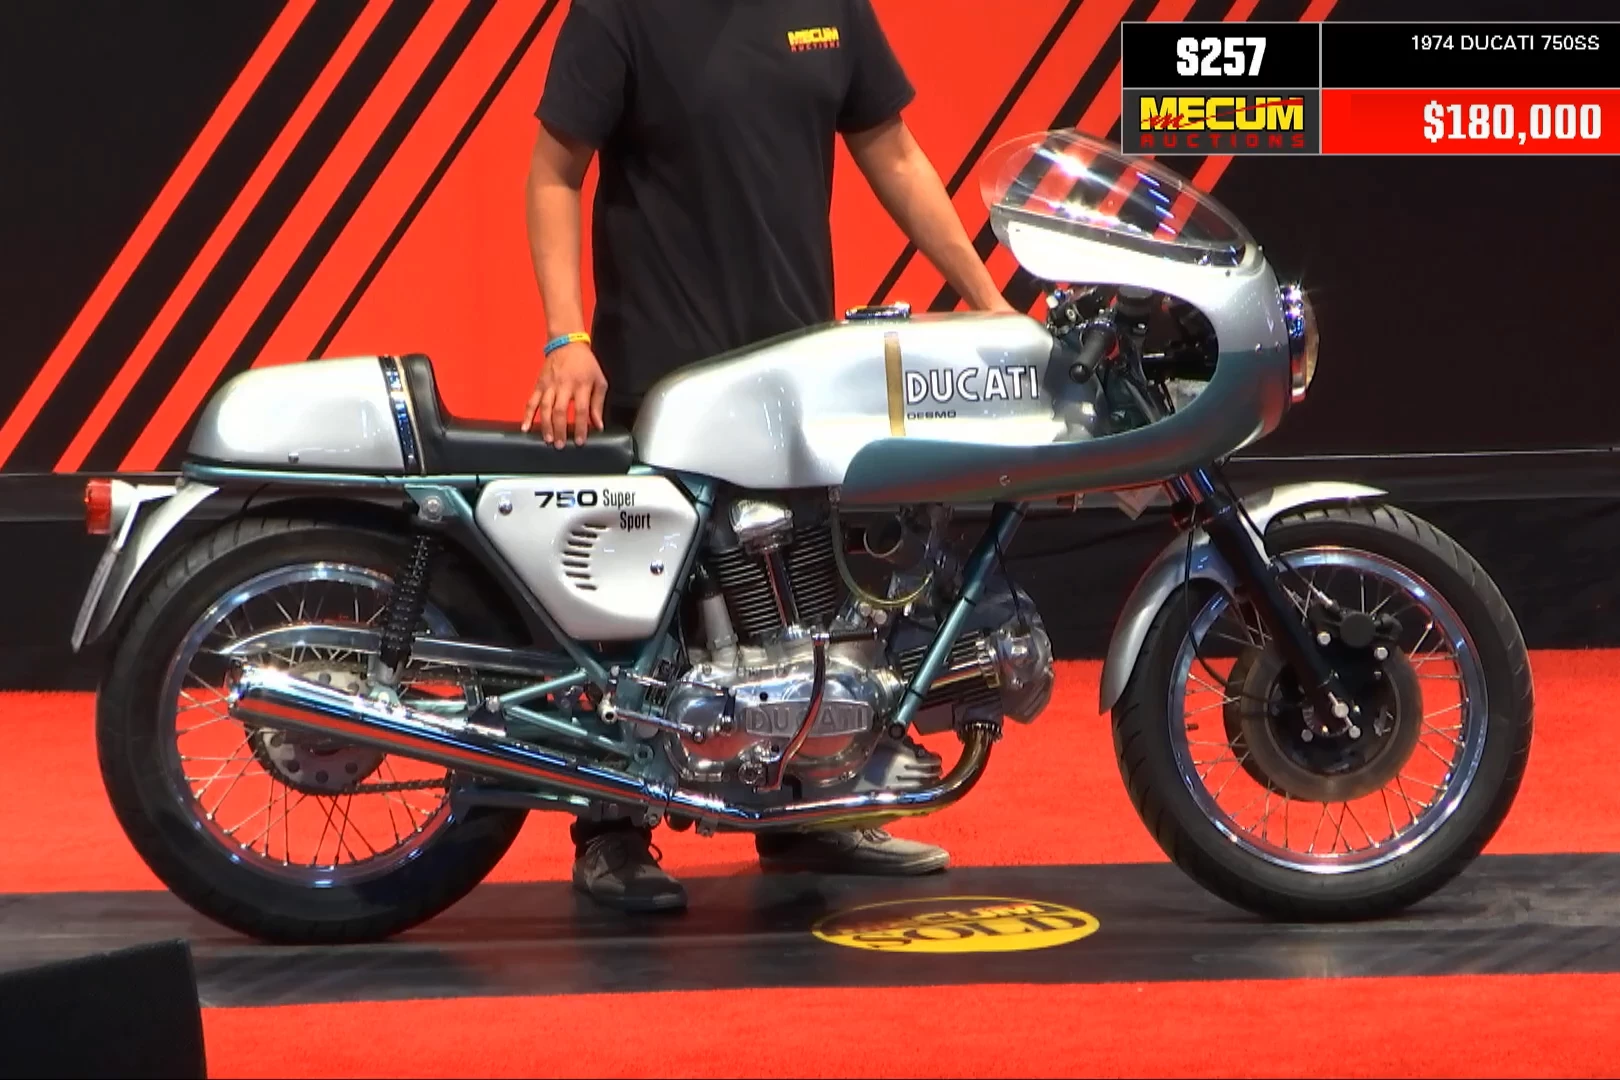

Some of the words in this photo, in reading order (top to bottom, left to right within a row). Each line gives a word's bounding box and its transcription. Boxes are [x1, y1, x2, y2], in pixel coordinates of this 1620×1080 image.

[786, 26, 840, 46] MECUM
[905, 365, 1039, 405] DUCATI
[907, 410, 957, 420] DESMO
[534, 489, 598, 508] 750
[602, 488, 636, 510] Super
[620, 511, 651, 532] Sport
[839, 903, 1046, 933] CUM
[853, 915, 1087, 948] SOLD
